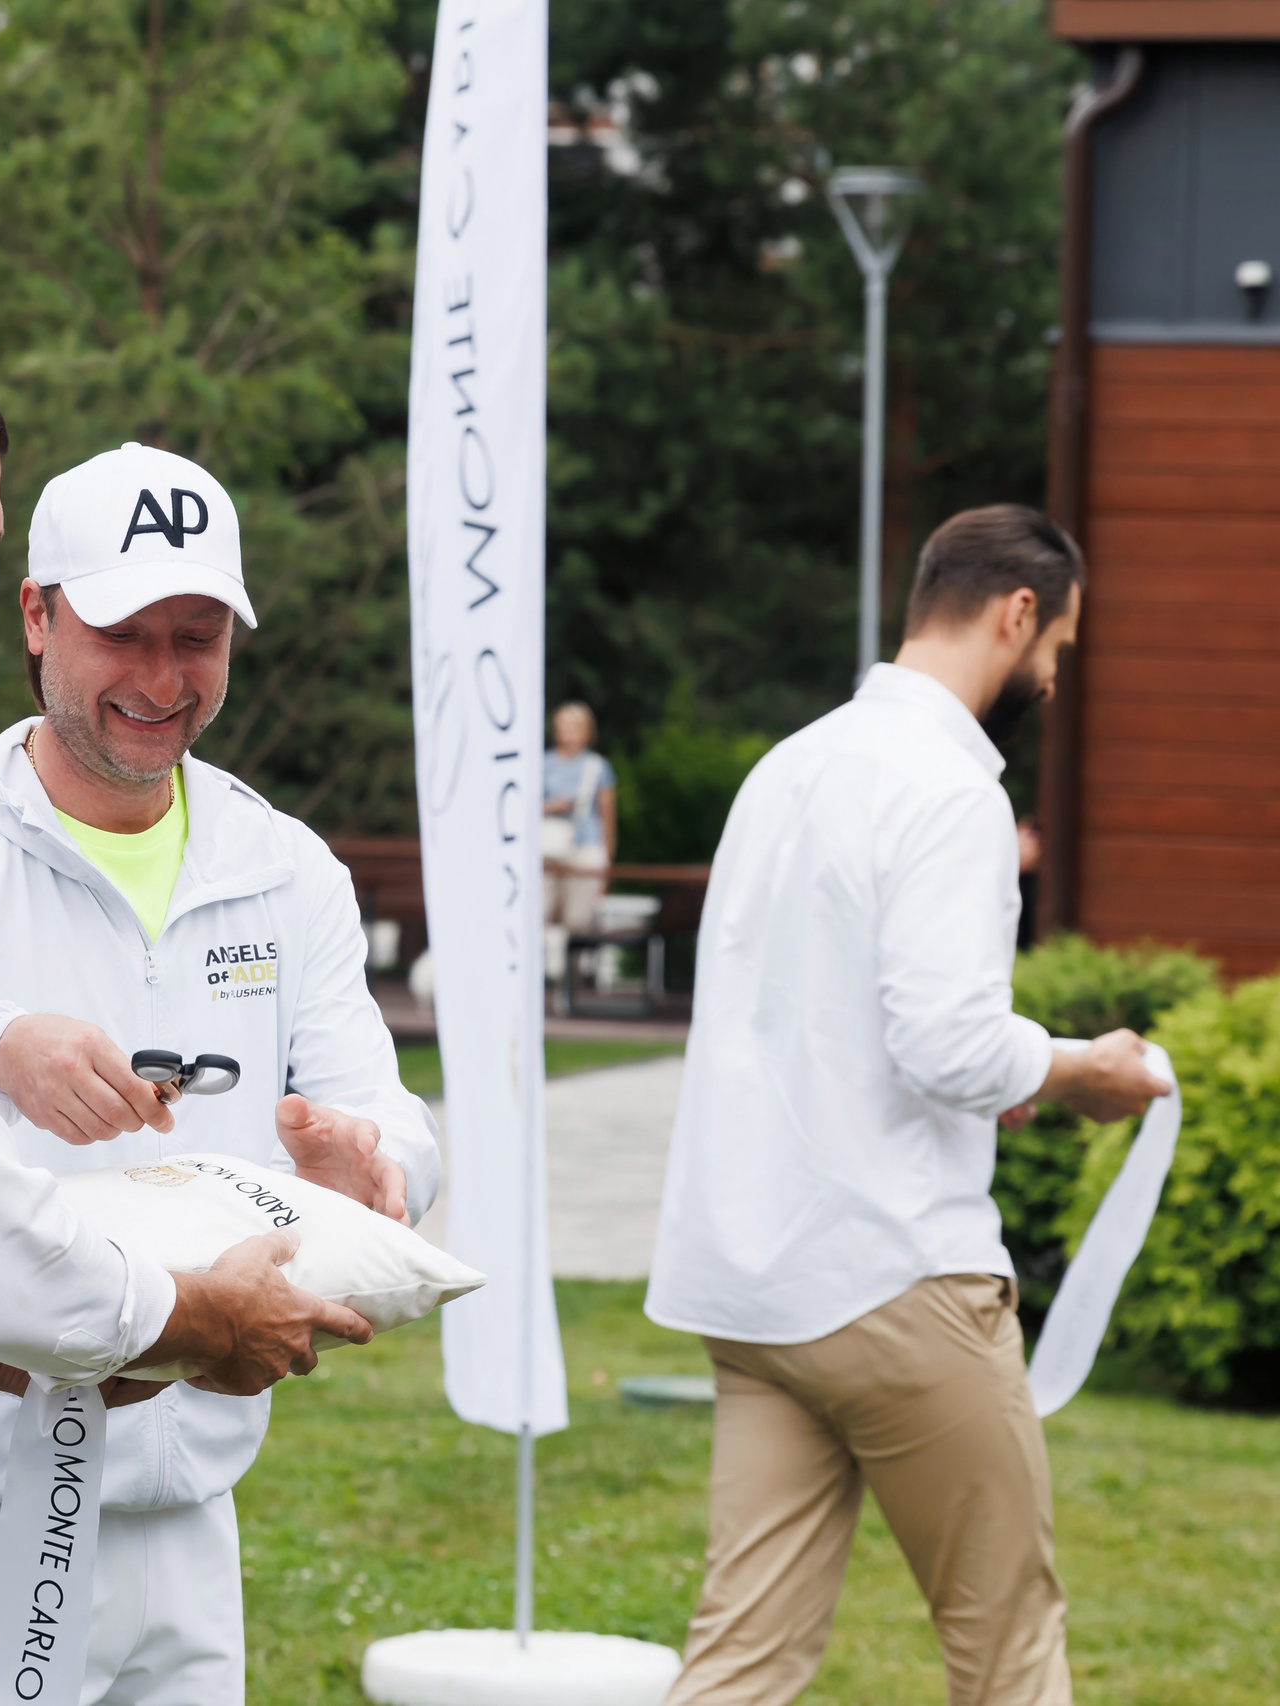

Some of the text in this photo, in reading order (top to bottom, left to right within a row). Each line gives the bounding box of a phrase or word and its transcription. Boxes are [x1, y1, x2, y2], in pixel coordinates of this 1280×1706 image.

[205, 942, 277, 967] ANGELS
[236, 1181, 300, 1228] RADIO
[39, 1453, 87, 1573] MONTE
[15, 1579, 64, 1701] CARLO
